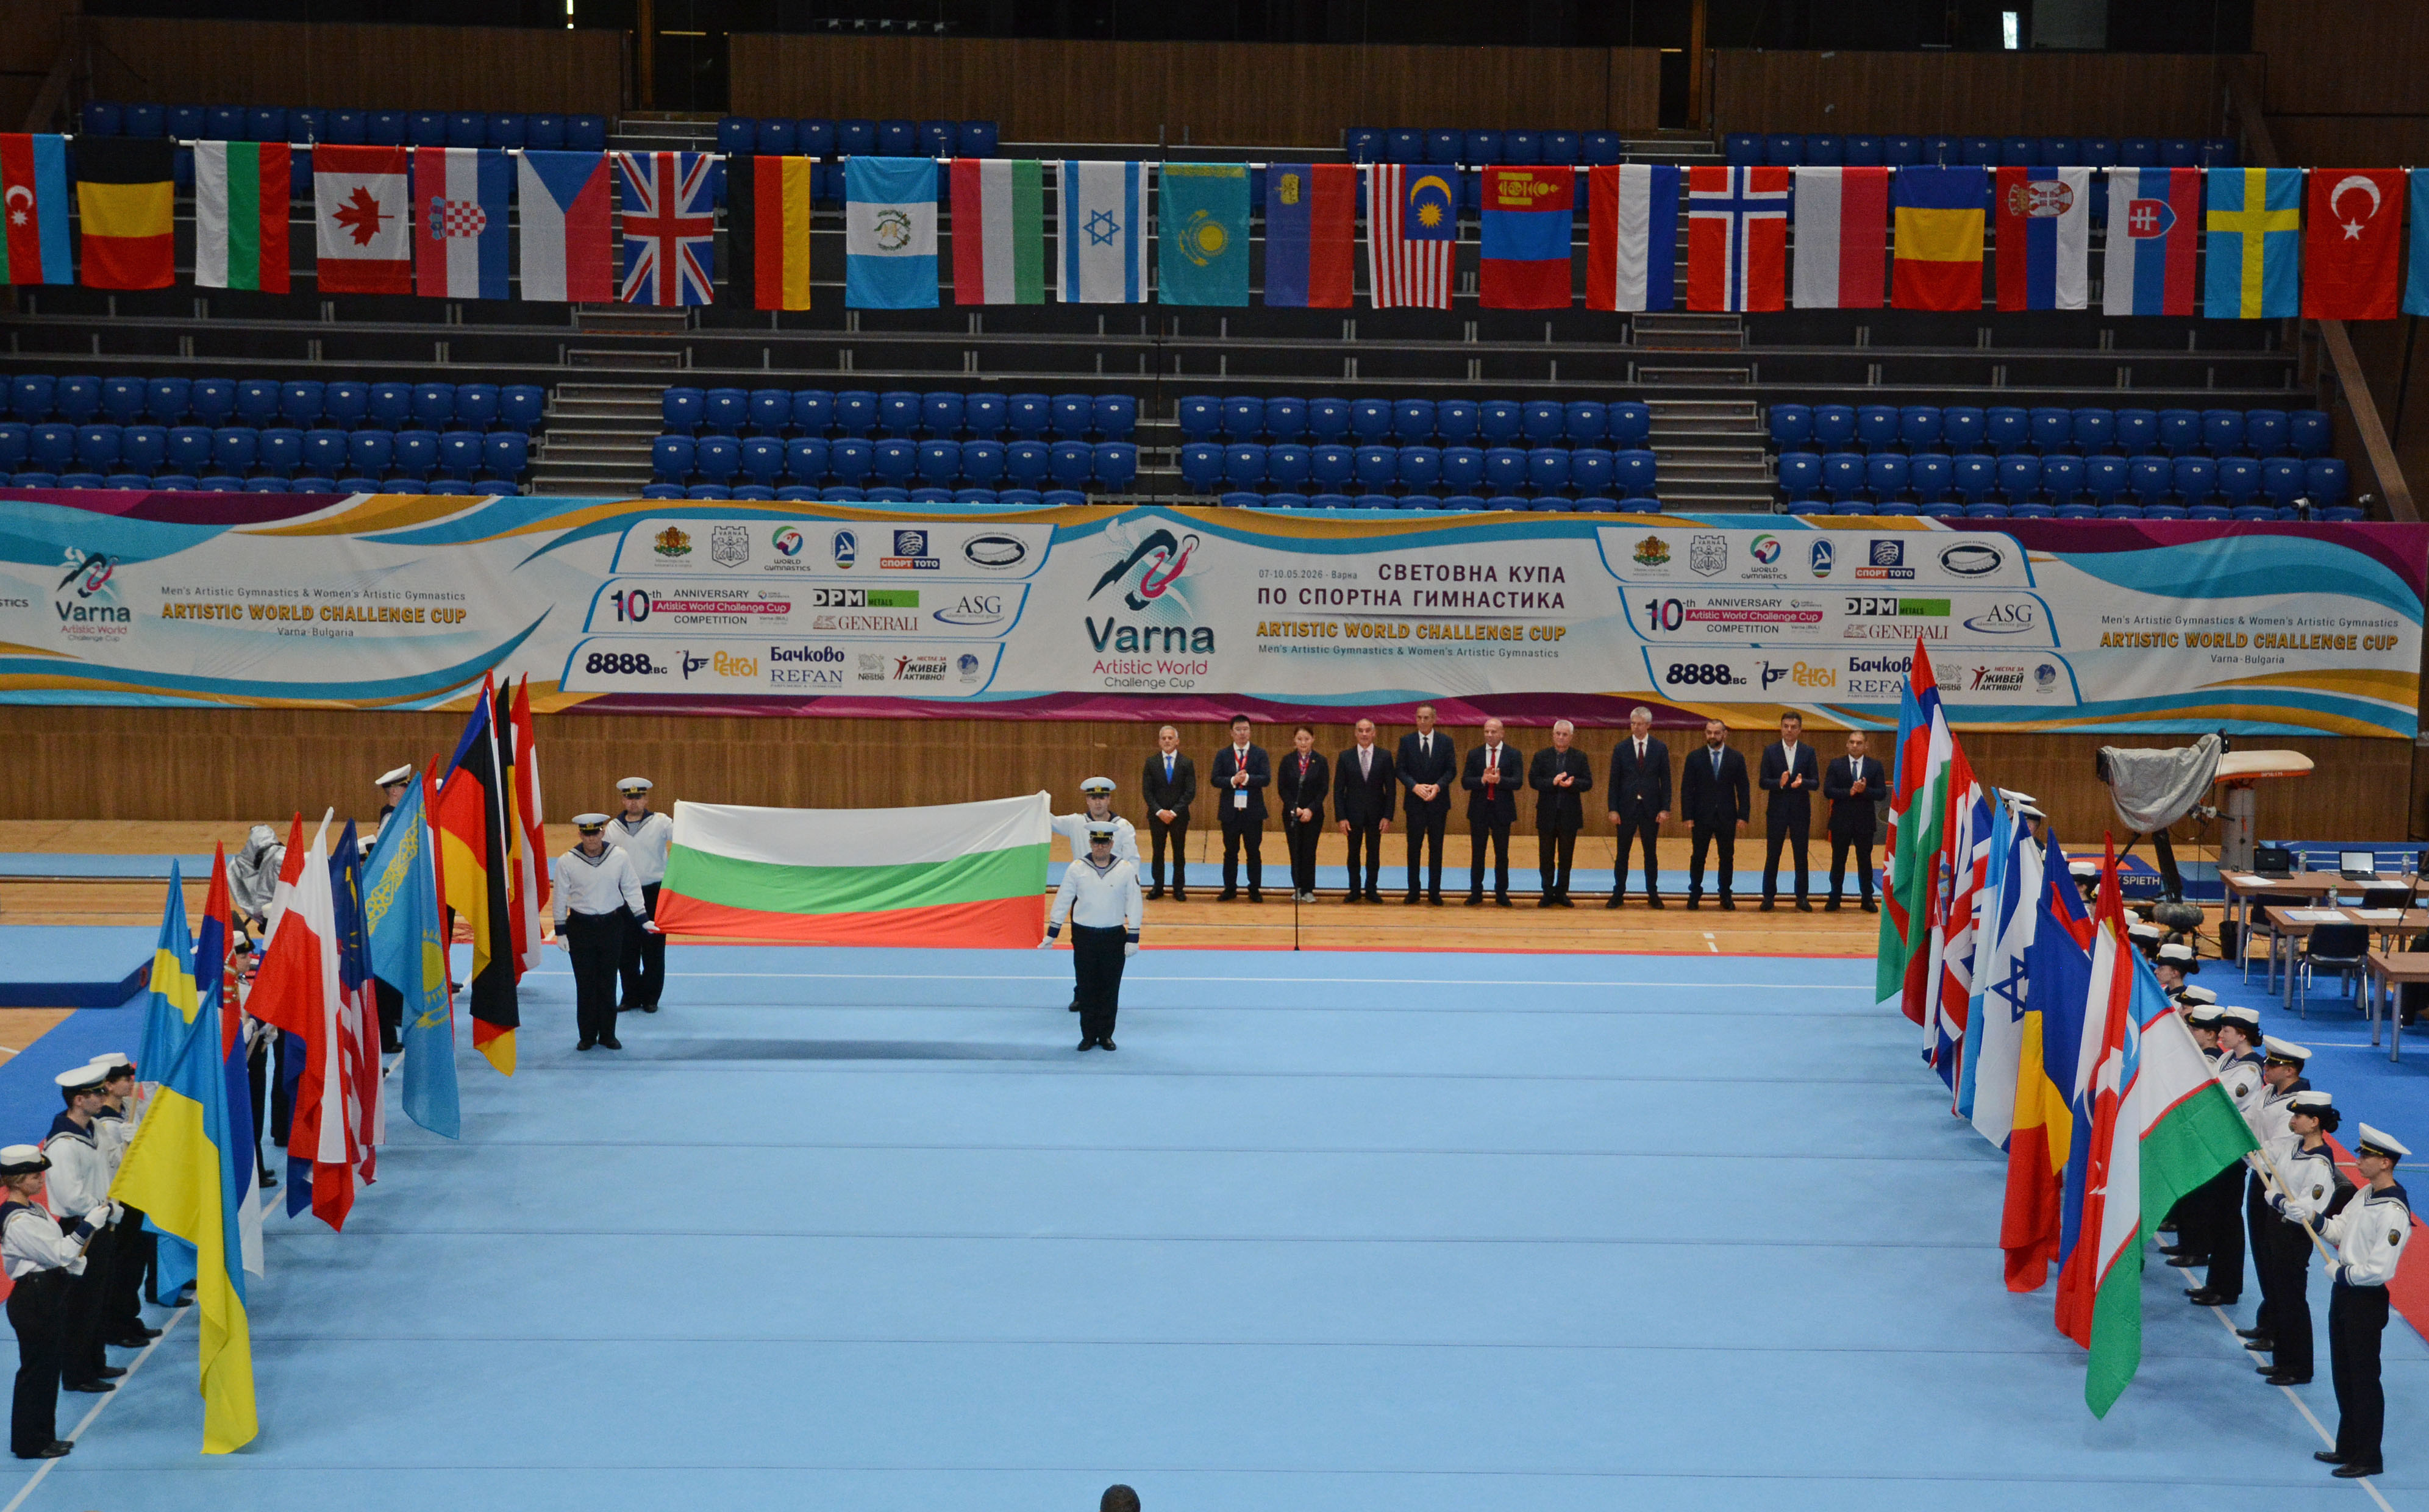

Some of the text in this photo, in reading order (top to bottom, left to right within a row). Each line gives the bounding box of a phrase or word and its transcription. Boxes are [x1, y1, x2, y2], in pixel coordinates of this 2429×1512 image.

[1258, 569, 1322, 579] 07-10.05.2026
[1331, 571, 1358, 580] Варна
[1379, 563, 1566, 583] СВЕТОВНА КУПА
[161, 587, 465, 601] Men's Artistic Gymnastics & Women's Artistic Gymnastics
[674, 590, 749, 599] ANNIVERSARY
[813, 588, 893, 607] DPM METALS
[1258, 587, 1565, 609] ПО СПОРТНА ГИМНАСТИКА
[656, 602, 786, 613] Artistic World Challenge Cup
[956, 595, 1000, 614] ASG
[1707, 598, 1783, 608] ANNIVERSARY
[1844, 597, 1897, 616] DPM
[55, 601, 131, 622] Varna
[162, 602, 467, 624] ARTISTIC WORLD CHALLENGE CUP
[1689, 611, 1819, 622] Artistic World Challenge Cup
[1986, 604, 2031, 622] ASG
[674, 615, 747, 624] COMPETITION
[838, 615, 918, 631] GENERALI
[2101, 615, 2399, 629] Men's Artistic Gymnastics & Women's Artistic Gymnastics
[62, 625, 127, 635] Artistic World
[277, 627, 306, 636] Varna
[312, 627, 354, 638] Bulgaria
[1084, 616, 1215, 654] Varna
[1256, 621, 1566, 641] ARTISTIC WORLD CHALLENGE CUP
[1707, 624, 1779, 633] COMPETITION
[1869, 624, 1949, 640] GENERALI
[2100, 632, 2399, 651] ARTISTIC WORLD CHALLENGE CUP
[770, 645, 845, 662] Бачково
[1258, 644, 1558, 659] Men's Artistic Gymnastics & Women's Artistic Gymnastics
[585, 652, 668, 675] 8888.BG
[1092, 659, 1208, 675] Artistic World
[1849, 656, 1913, 673] Бачков
[2211, 654, 2238, 663] Varna
[2244, 654, 2285, 665] Bulgaria
[907, 662, 947, 673] ЖИВЕЙ
[1666, 663, 1747, 685] 8888.BG
[771, 669, 843, 683] REFAN
[1104, 676, 1195, 690] Challenge Cup
[1984, 672, 2024, 683] ЖИВЕЙ
[1848, 679, 1903, 693] REFA
[2122, 875, 2160, 885] SPIETH
